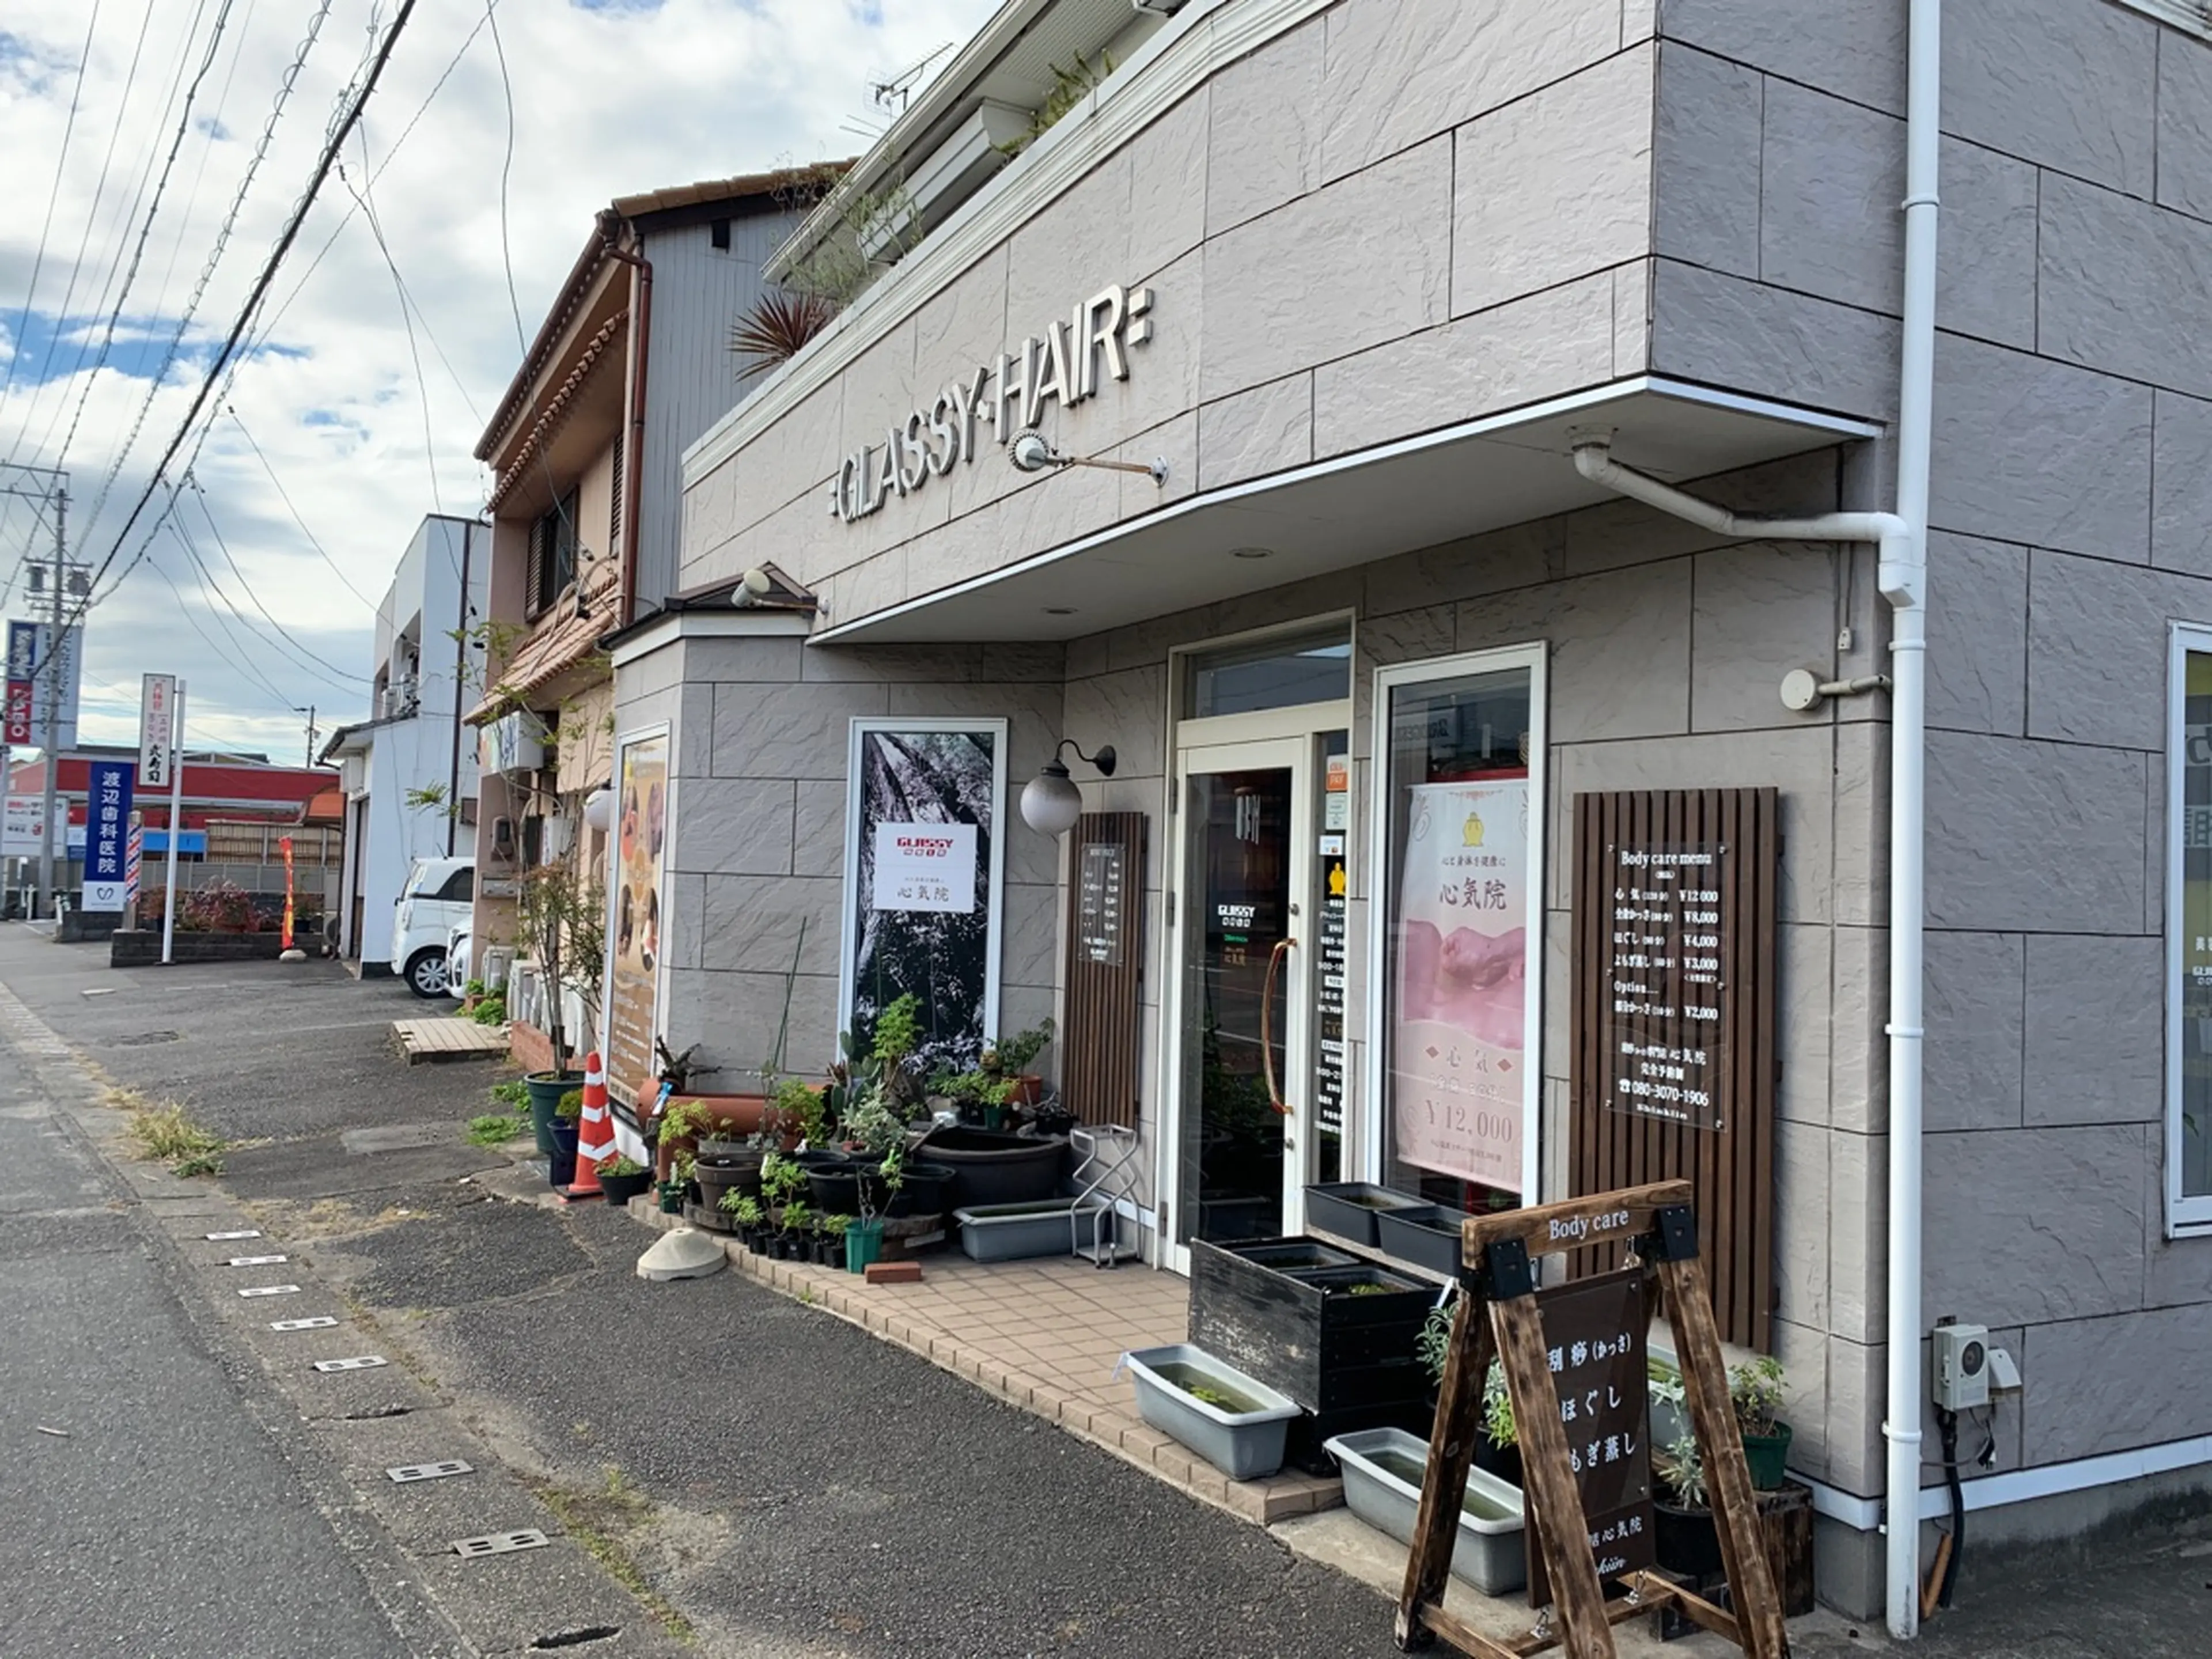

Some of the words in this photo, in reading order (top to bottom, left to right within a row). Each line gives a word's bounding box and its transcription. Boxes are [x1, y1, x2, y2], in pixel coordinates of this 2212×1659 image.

[97, 771, 122, 874] 渡辺歯科医院
[1621, 850, 1649, 869] Body
[1651, 854, 1677, 865] care
[1679, 854, 1712, 865] menu
[1440, 876, 1507, 910] 心気院
[1549, 1215, 1589, 1240] Body
[1593, 1210, 1629, 1232] care
[1561, 1385, 1621, 1422] ほぐし
[1570, 1433, 1636, 1472] もぎ蒸し
